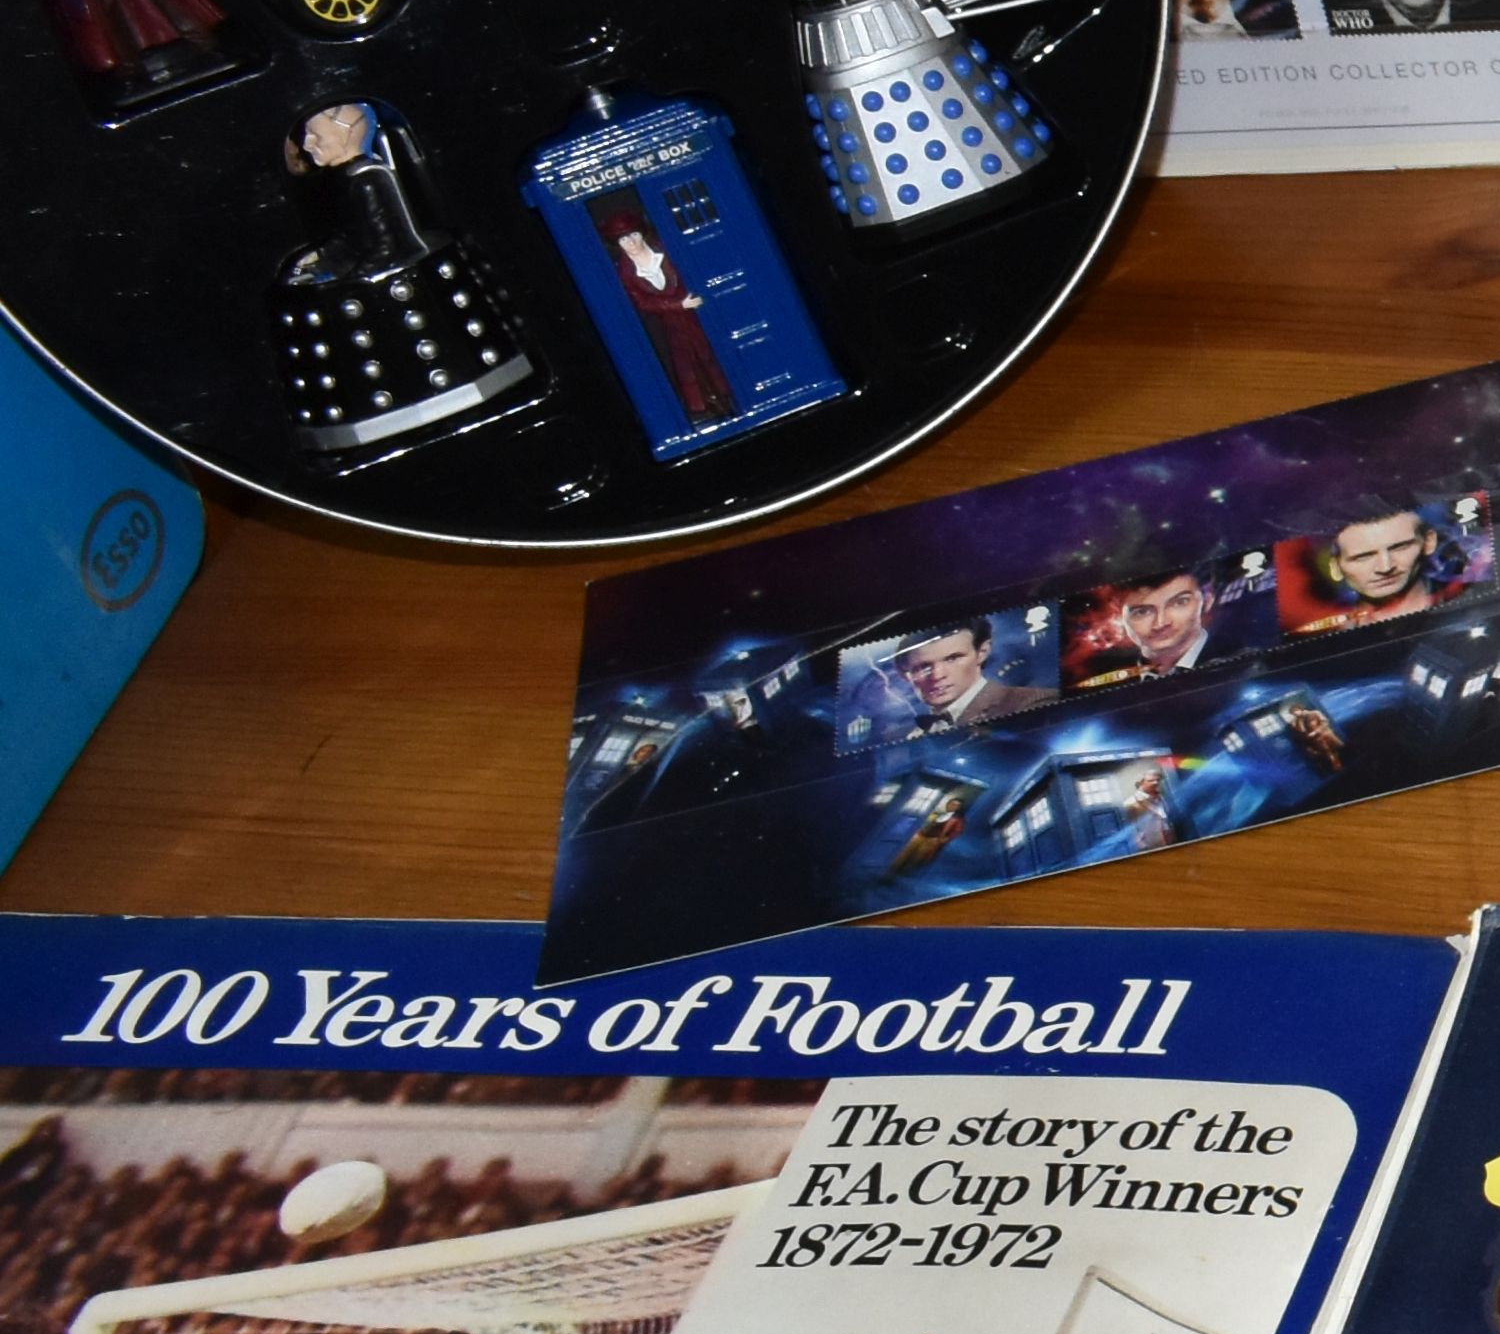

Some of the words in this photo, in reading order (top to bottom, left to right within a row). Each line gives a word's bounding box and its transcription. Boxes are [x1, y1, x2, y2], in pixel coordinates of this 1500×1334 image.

[1219, 66, 1318, 84] EDITION
[1330, 61, 1478, 80] COLLECTOR
[658, 142, 691, 161] BOX
[570, 165, 626, 192] POLICE
[61, 969, 269, 1044] 100
[273, 970, 576, 1051] Years
[588, 975, 732, 1052] of
[708, 975, 1191, 1055] Football
[827, 1104, 940, 1148] The
[948, 1108, 1116, 1158] story
[1118, 1108, 1195, 1149] of
[1196, 1111, 1293, 1155] the
[1043, 1163, 1303, 1217] Winners
[755, 1223, 1062, 1268] 1872-1972
